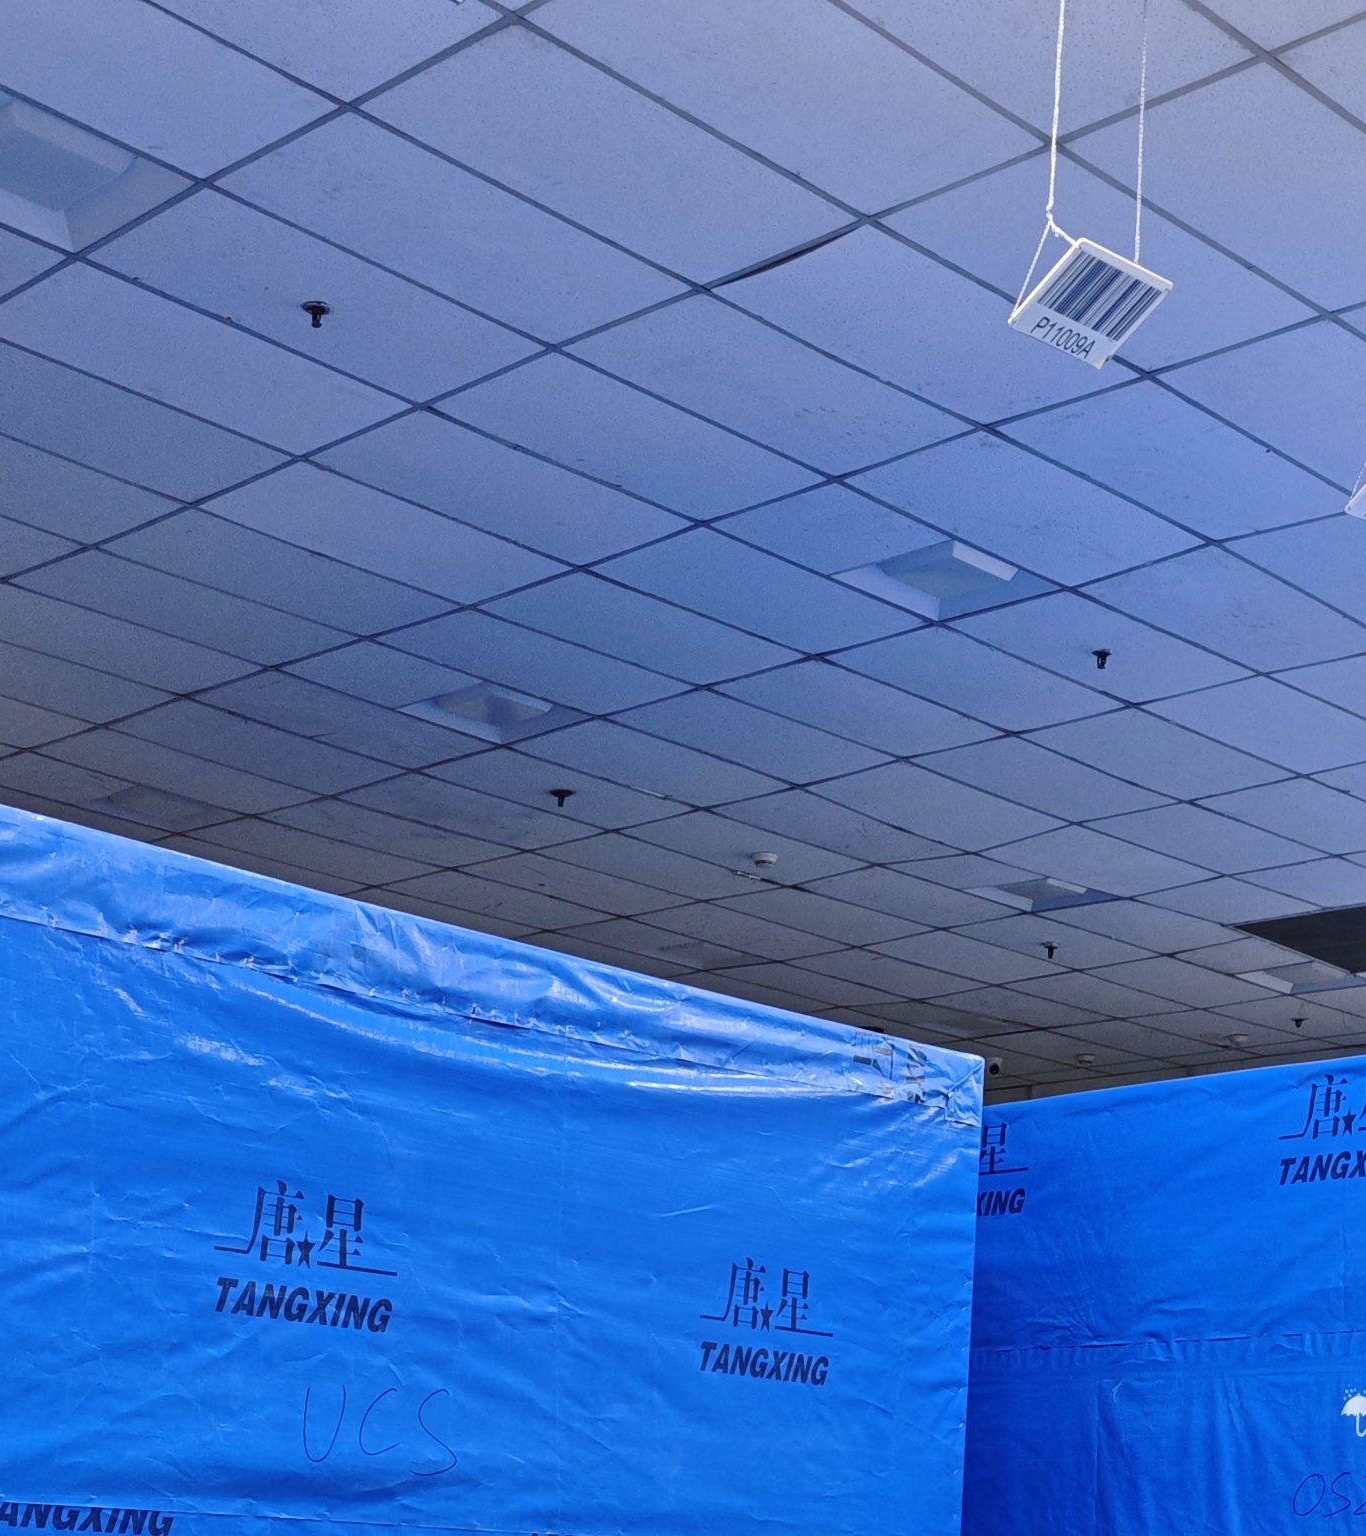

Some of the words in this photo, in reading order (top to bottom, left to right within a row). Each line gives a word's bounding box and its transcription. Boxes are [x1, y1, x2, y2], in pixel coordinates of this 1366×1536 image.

[1030, 316, 1096, 360] P11009A
[213, 1179, 397, 1276] 唐星
[214, 1276, 393, 1333] TANGXING
[699, 1256, 834, 1337] 唐星
[700, 1341, 829, 1386] TANGXING
[304, 1385, 457, 1476] UCS
